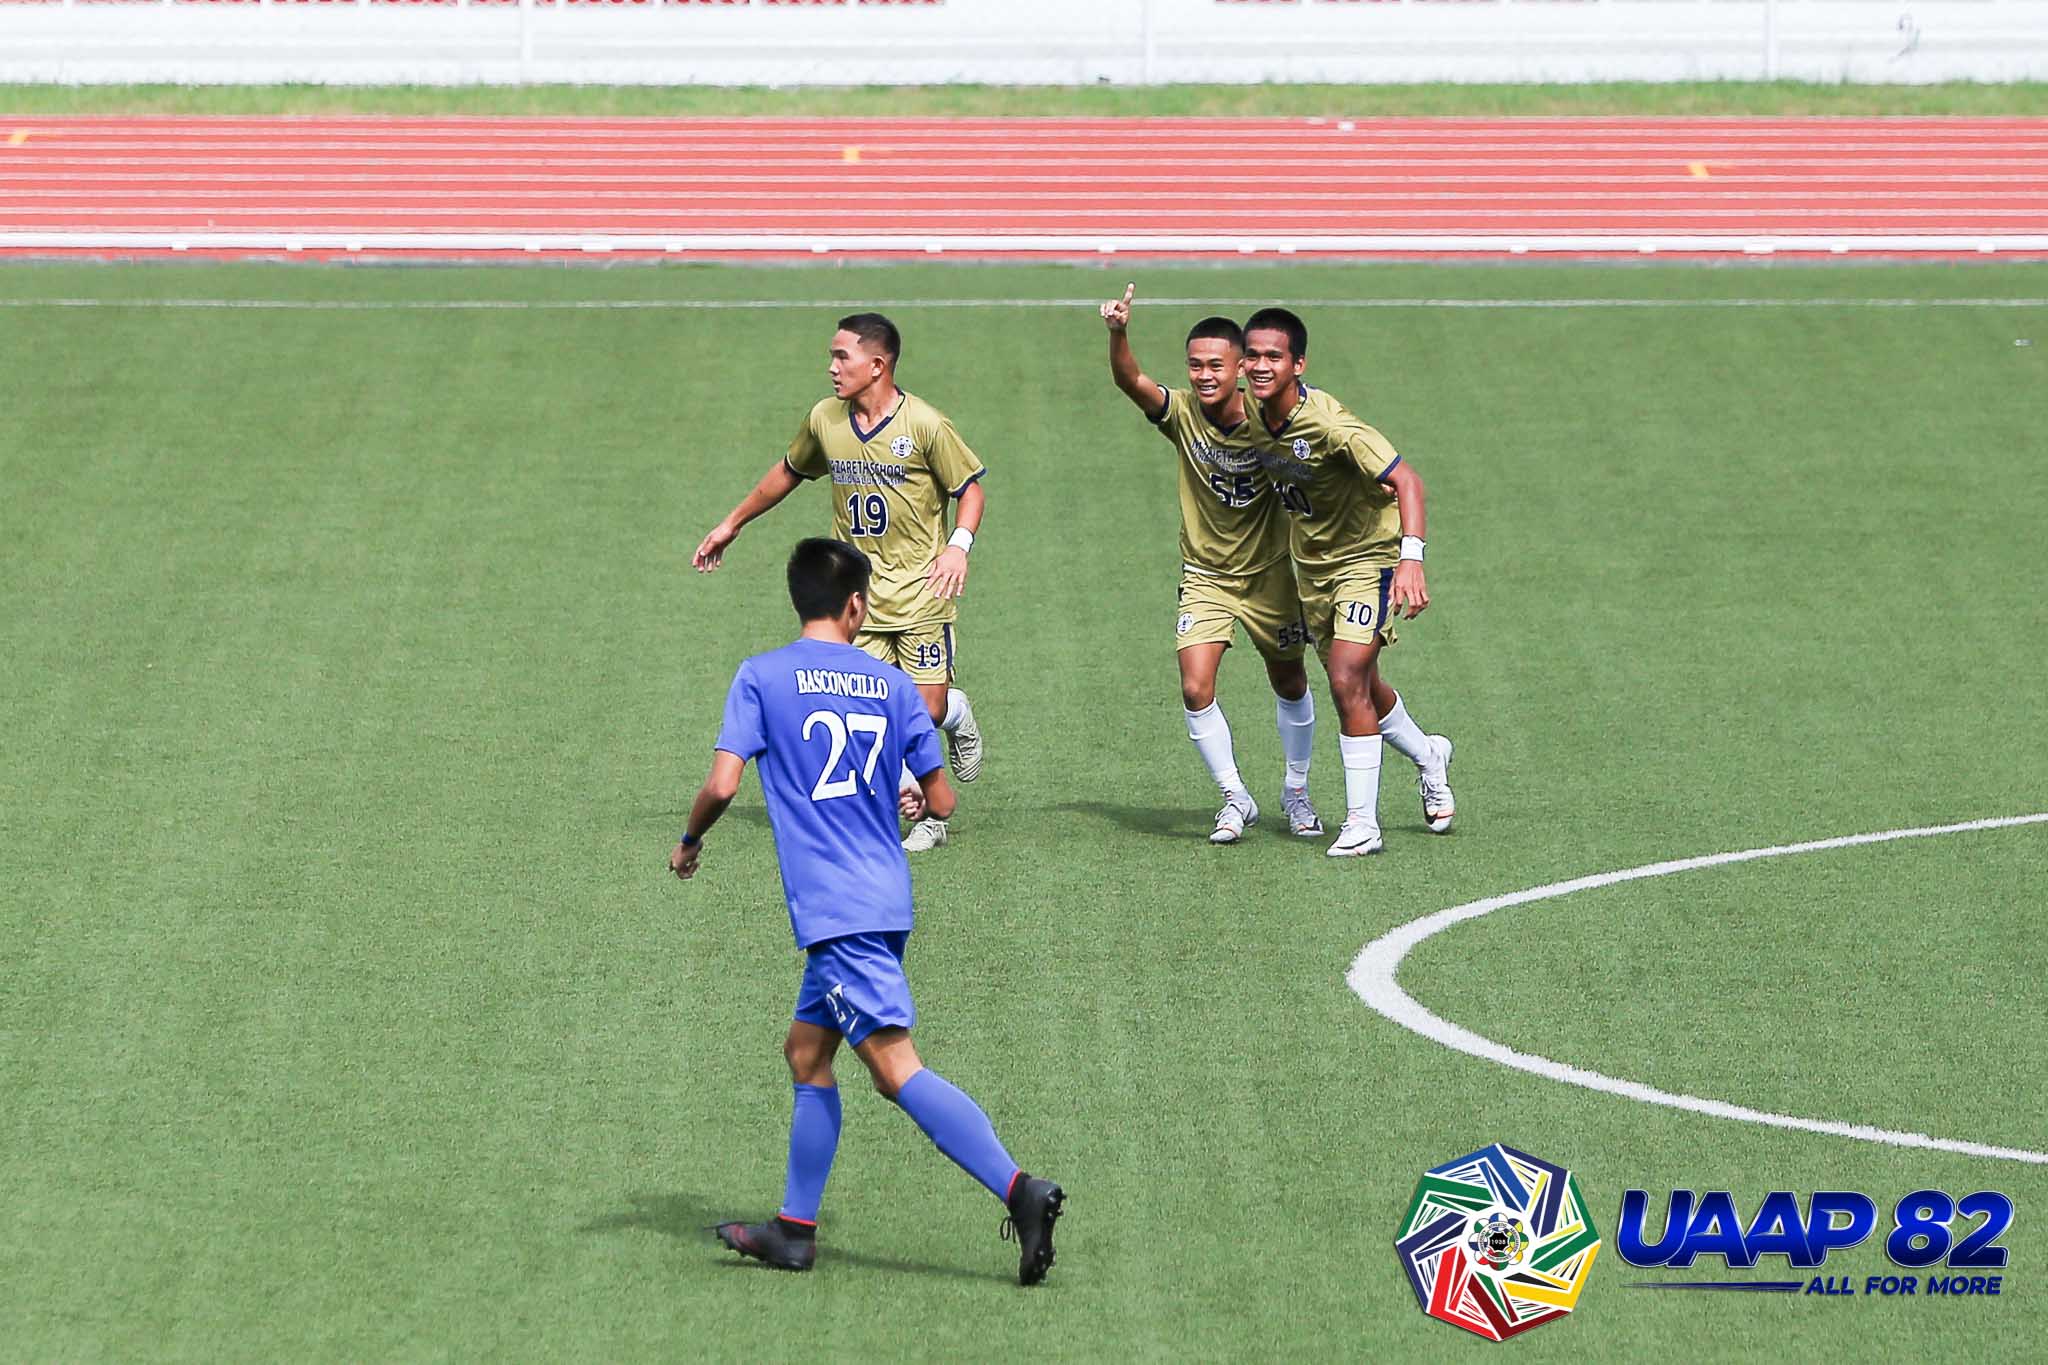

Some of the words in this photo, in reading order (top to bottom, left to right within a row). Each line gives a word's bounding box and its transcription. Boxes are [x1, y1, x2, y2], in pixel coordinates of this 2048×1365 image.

[1208, 472, 1257, 508] 55
[848, 491, 889, 537] 19
[1346, 601, 1373, 626] 10
[917, 642, 942, 669] 19
[794, 668, 889, 701] BASCONCILLO
[801, 709, 888, 802] 27
